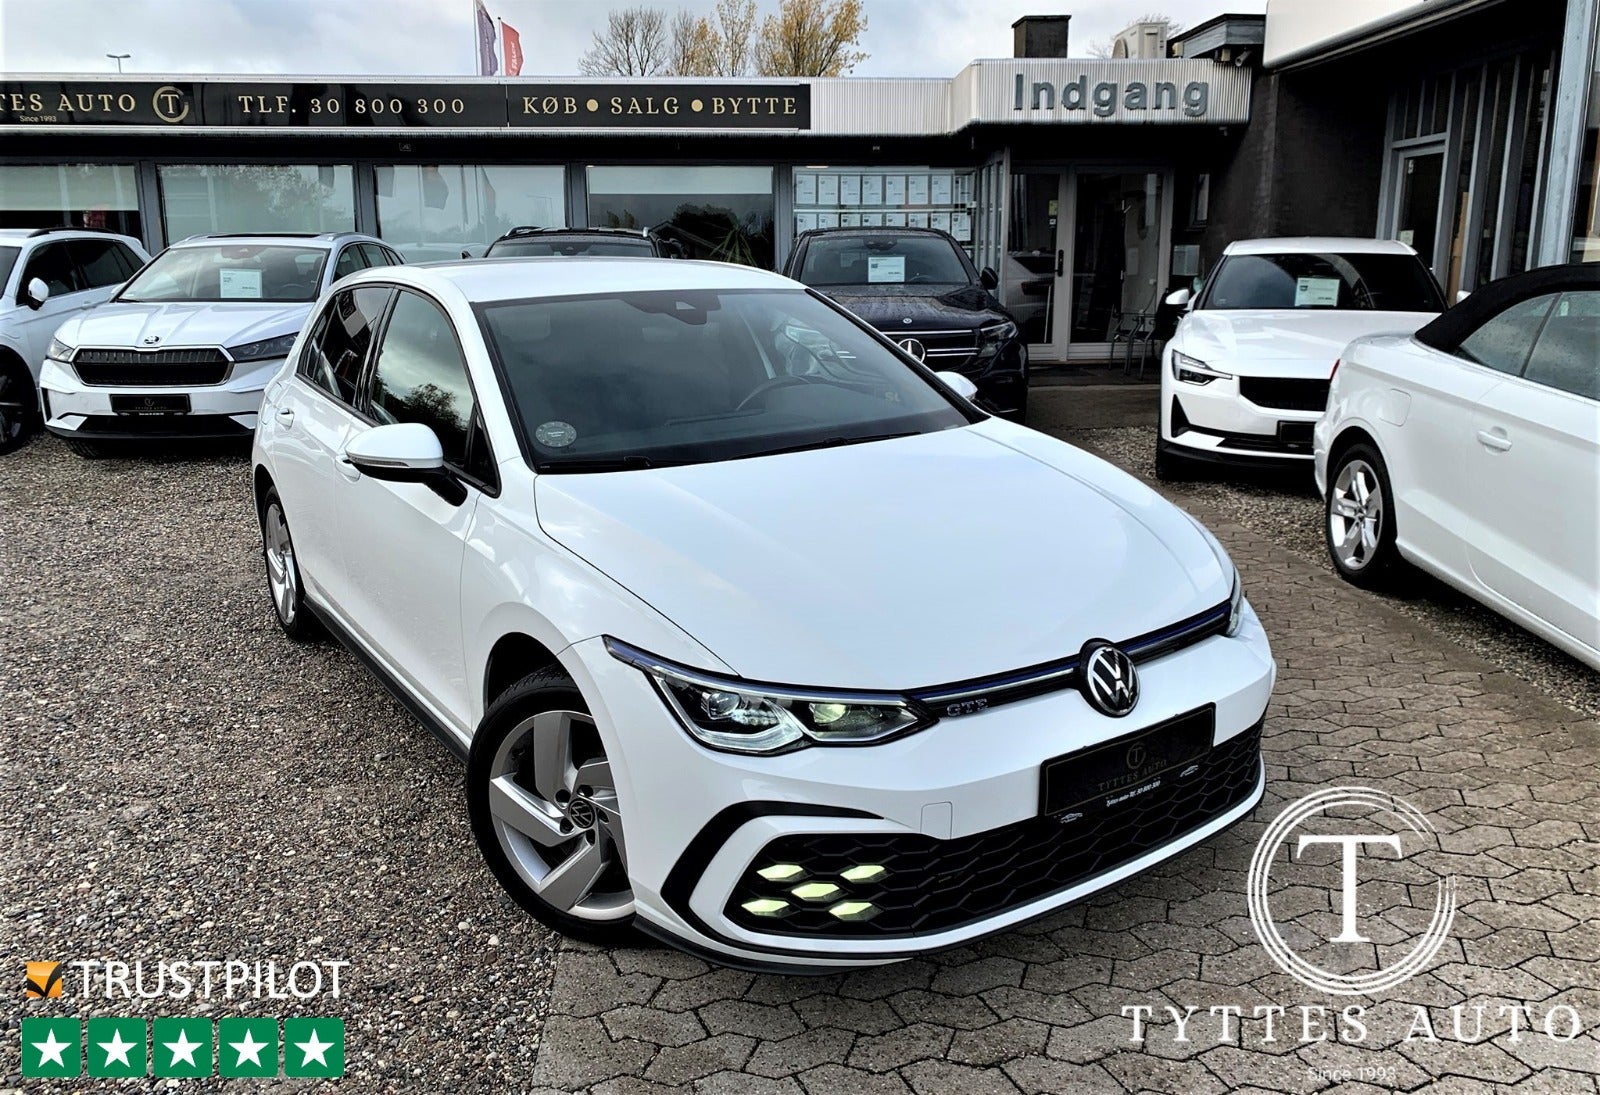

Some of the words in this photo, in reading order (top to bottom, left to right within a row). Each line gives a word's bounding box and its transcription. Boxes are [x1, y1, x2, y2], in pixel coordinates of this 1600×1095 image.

[57, 93, 136, 112] AUTO
[238, 95, 296, 113] TLF.
[310, 98, 341, 114] 30
[355, 98, 403, 114] 800
[417, 98, 465, 114] 300
[1013, 73, 1209, 117] Indgang
[522, 96, 578, 115] KØB
[610, 96, 680, 115] SALG
[712, 96, 797, 115] BYTTE
[946, 698, 988, 717] GTE
